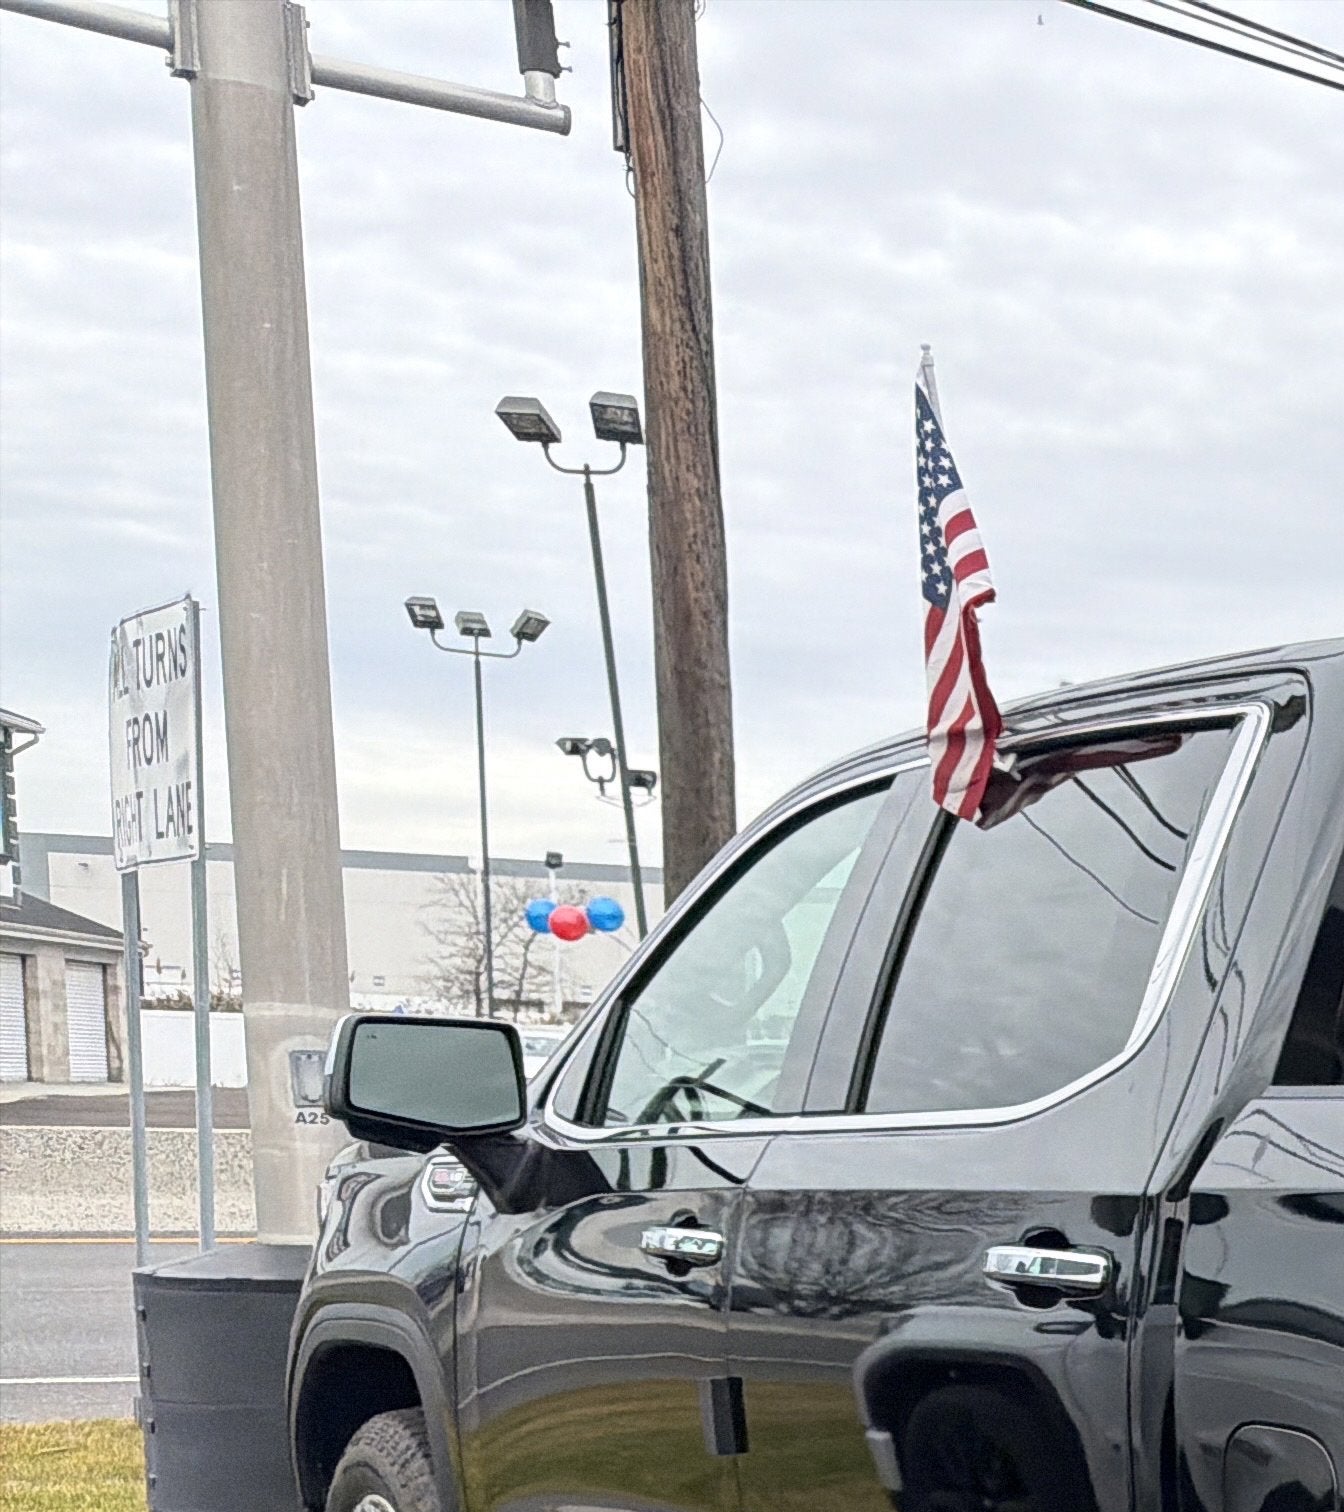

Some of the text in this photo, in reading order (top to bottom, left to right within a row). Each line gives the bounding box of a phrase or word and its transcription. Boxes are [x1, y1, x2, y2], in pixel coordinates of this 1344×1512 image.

[133, 623, 187, 690] TURNS
[126, 710, 169, 770] FROM
[115, 781, 193, 849] RIGHT LANE
[294, 1111, 331, 1126] A25
